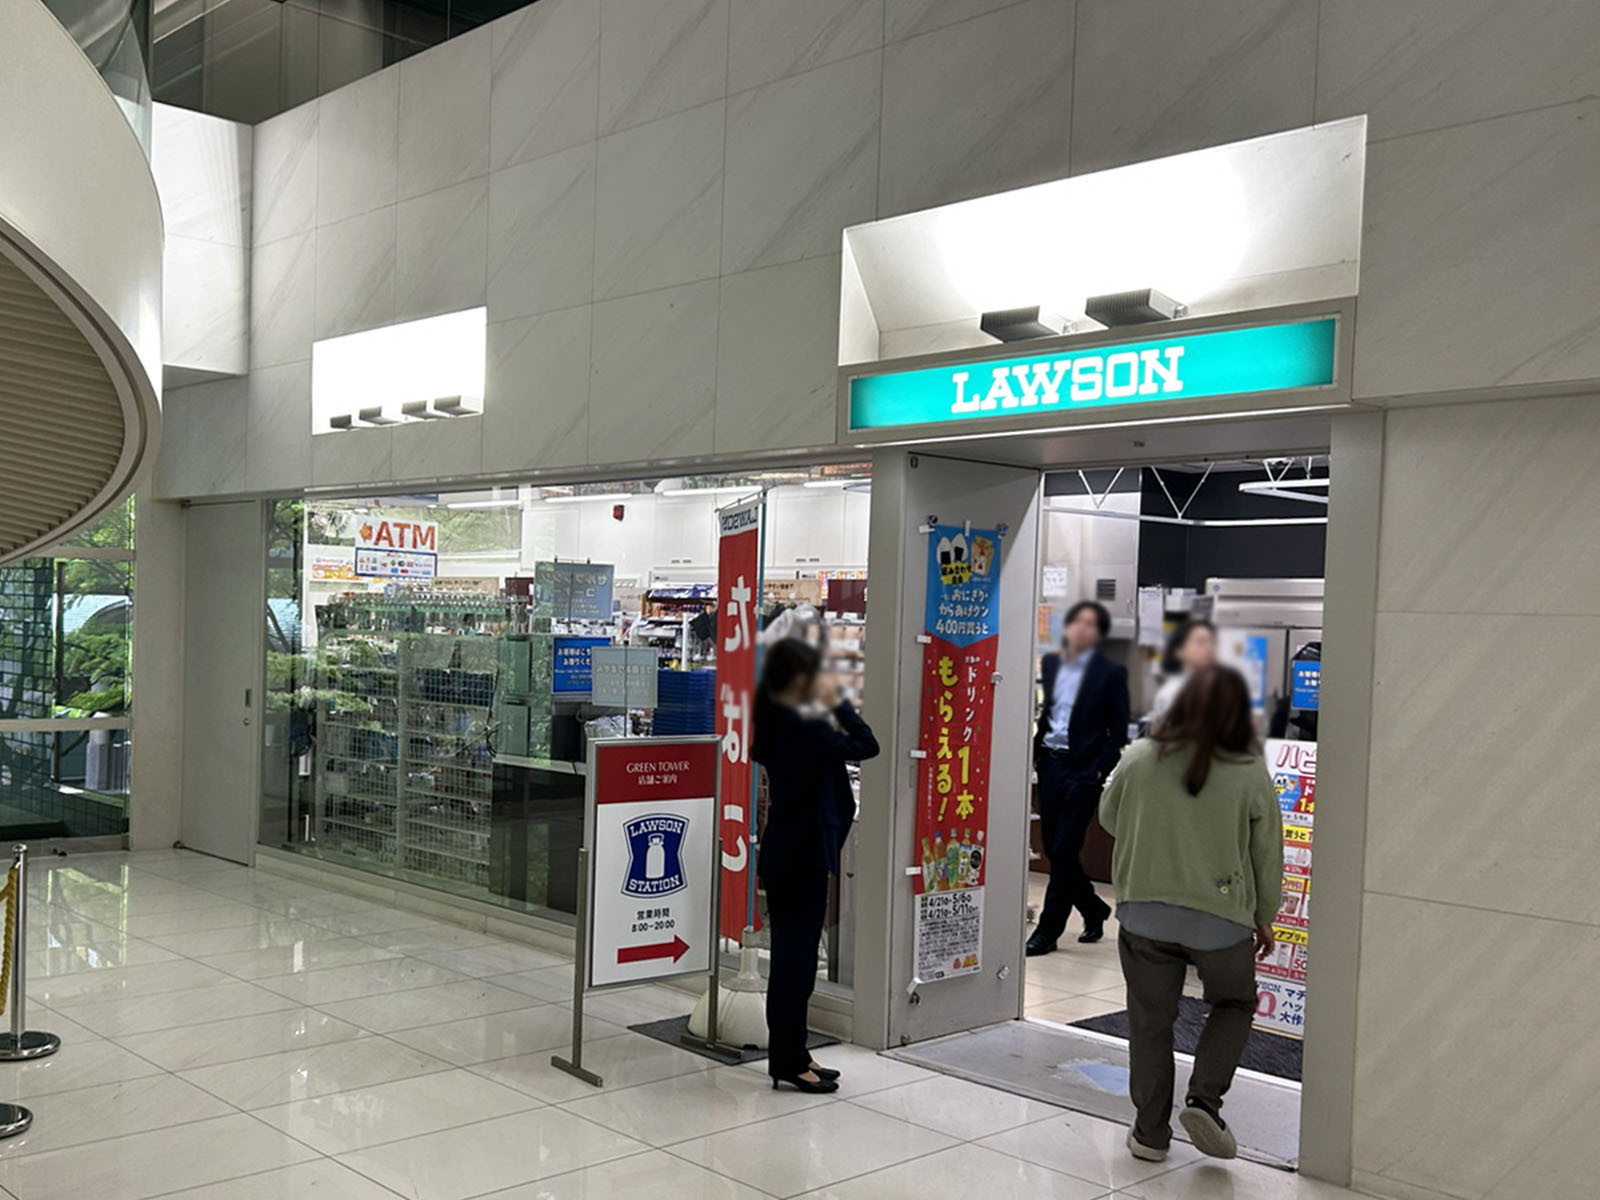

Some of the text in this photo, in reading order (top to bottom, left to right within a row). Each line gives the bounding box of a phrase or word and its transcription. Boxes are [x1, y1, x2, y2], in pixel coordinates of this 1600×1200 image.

[951, 345, 1185, 414] LAWSON
[373, 520, 436, 550] ATM
[938, 603, 990, 617] からあげクン
[935, 618, 989, 635] 400円買うと
[626, 760, 690, 774] GREEN TOWER
[638, 773, 678, 785] 店舗ご案内
[630, 819, 683, 837] LAWSON
[628, 874, 681, 893] STATION
[636, 908, 670, 920] 営業時間
[631, 919, 675, 932] 8:00-20:00
